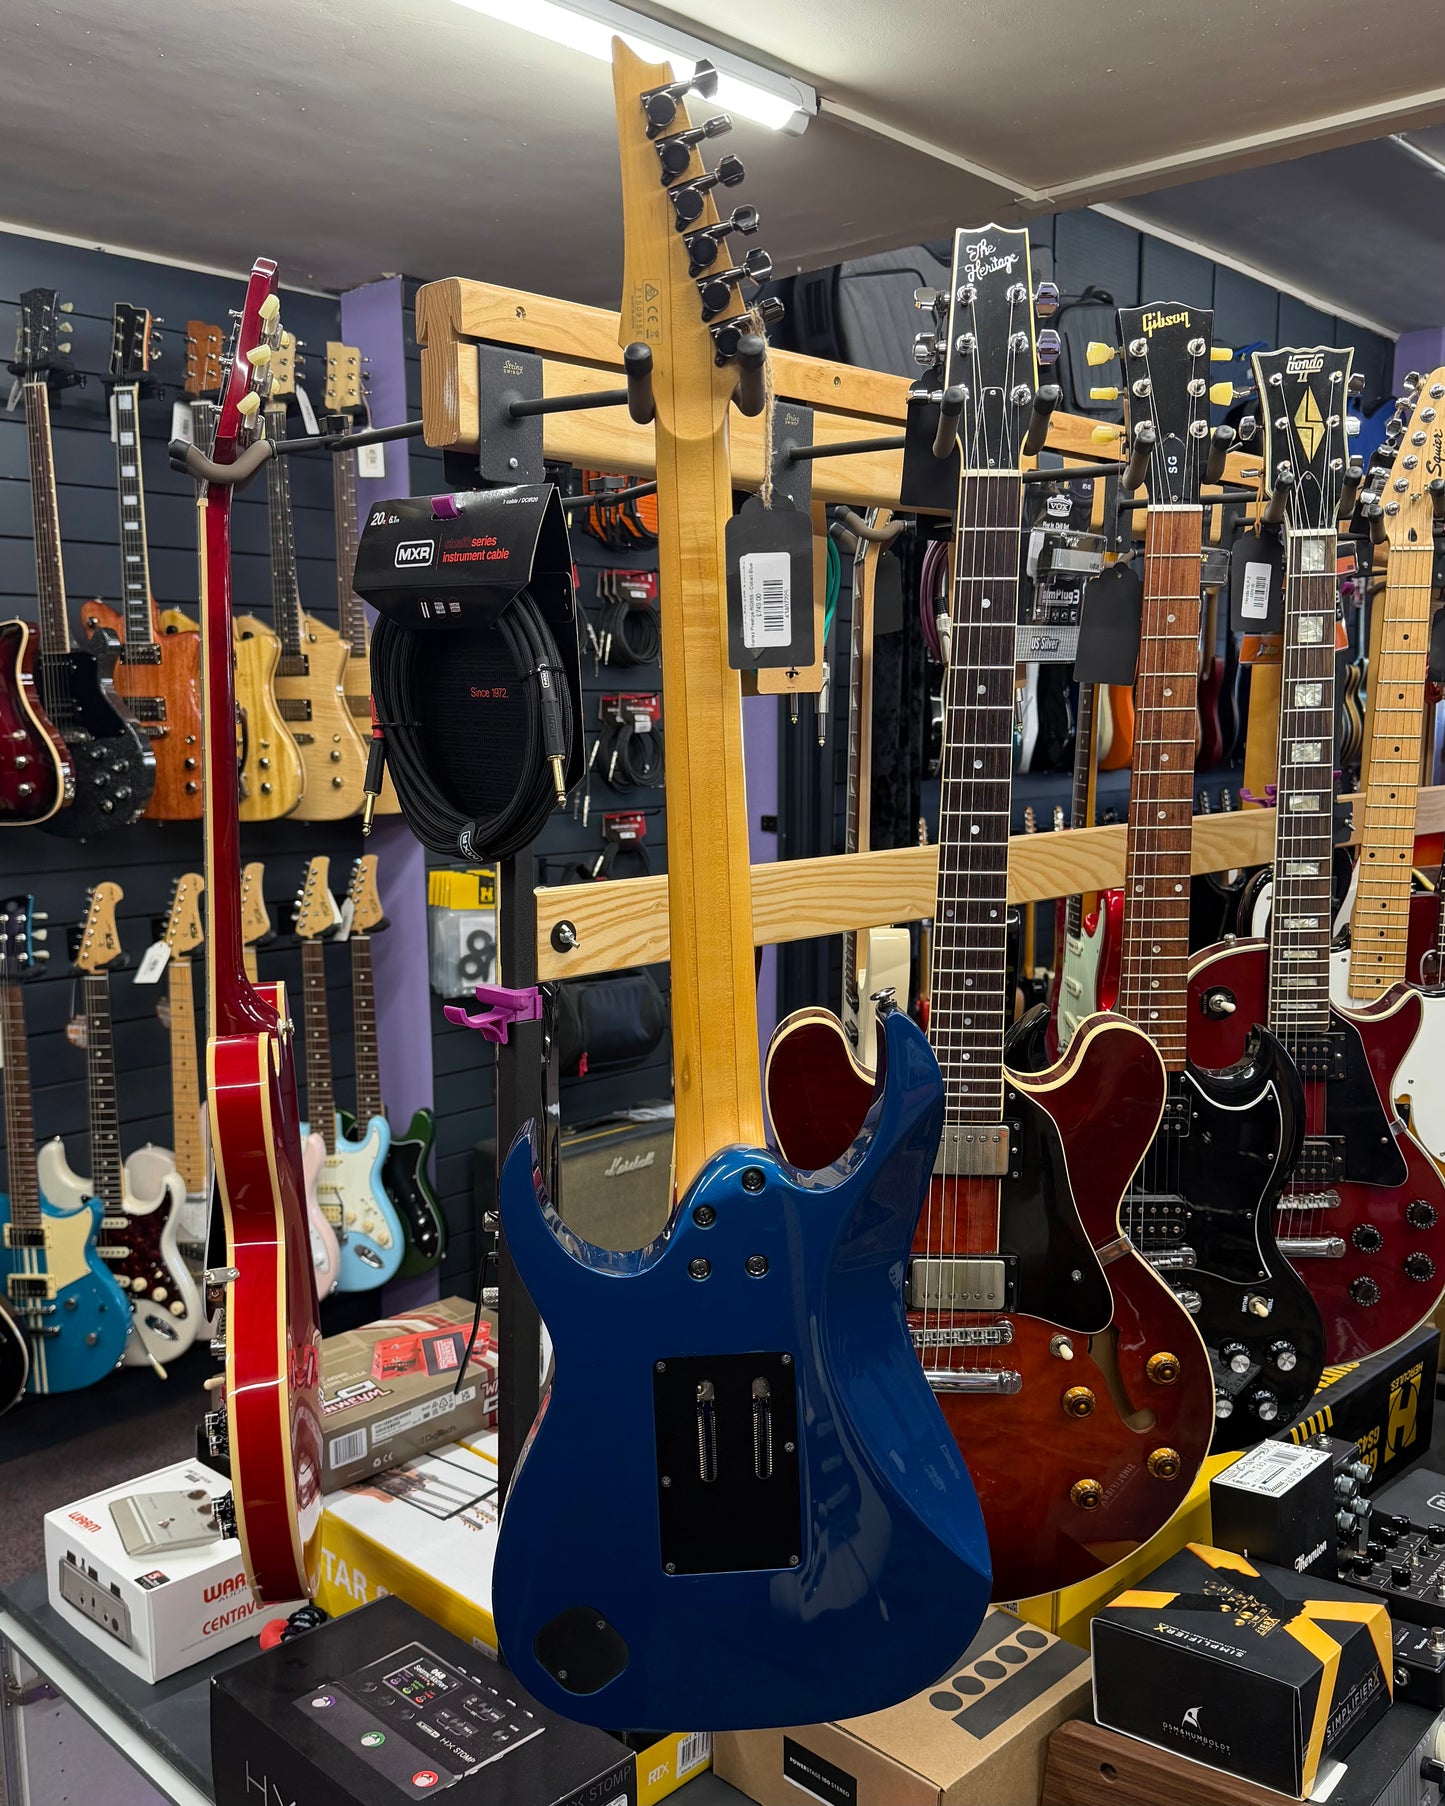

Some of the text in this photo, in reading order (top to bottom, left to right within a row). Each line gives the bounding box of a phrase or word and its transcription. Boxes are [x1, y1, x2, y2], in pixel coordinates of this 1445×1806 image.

[966, 238, 997, 262] The
[964, 253, 1020, 282] Heritage
[1142, 311, 1191, 338] Gibson
[1286, 353, 1325, 375] Hondo
[1168, 455, 1178, 474] SG
[1426, 428, 1445, 477] Squier
[1050, 502, 1069, 511] VOX
[398, 547, 431, 561] MXR
[442, 548, 510, 563] instrument cable
[1031, 636, 1059, 651] US Silver
[470, 686, 509, 699] Since 1972.
[604, 1151, 655, 1176] Marshall
[1389, 1360, 1424, 1391] HERCULES
[68, 1511, 102, 1534] WARM
[203, 1572, 247, 1604] WAR
[440, 1737, 476, 1763] HX STOMP
[590, 1764, 632, 1801] STOMP
[648, 1761, 670, 1786] RTX
[789, 1756, 821, 1781] POWERSTAGE
[831, 1782, 850, 1798] STEREO
